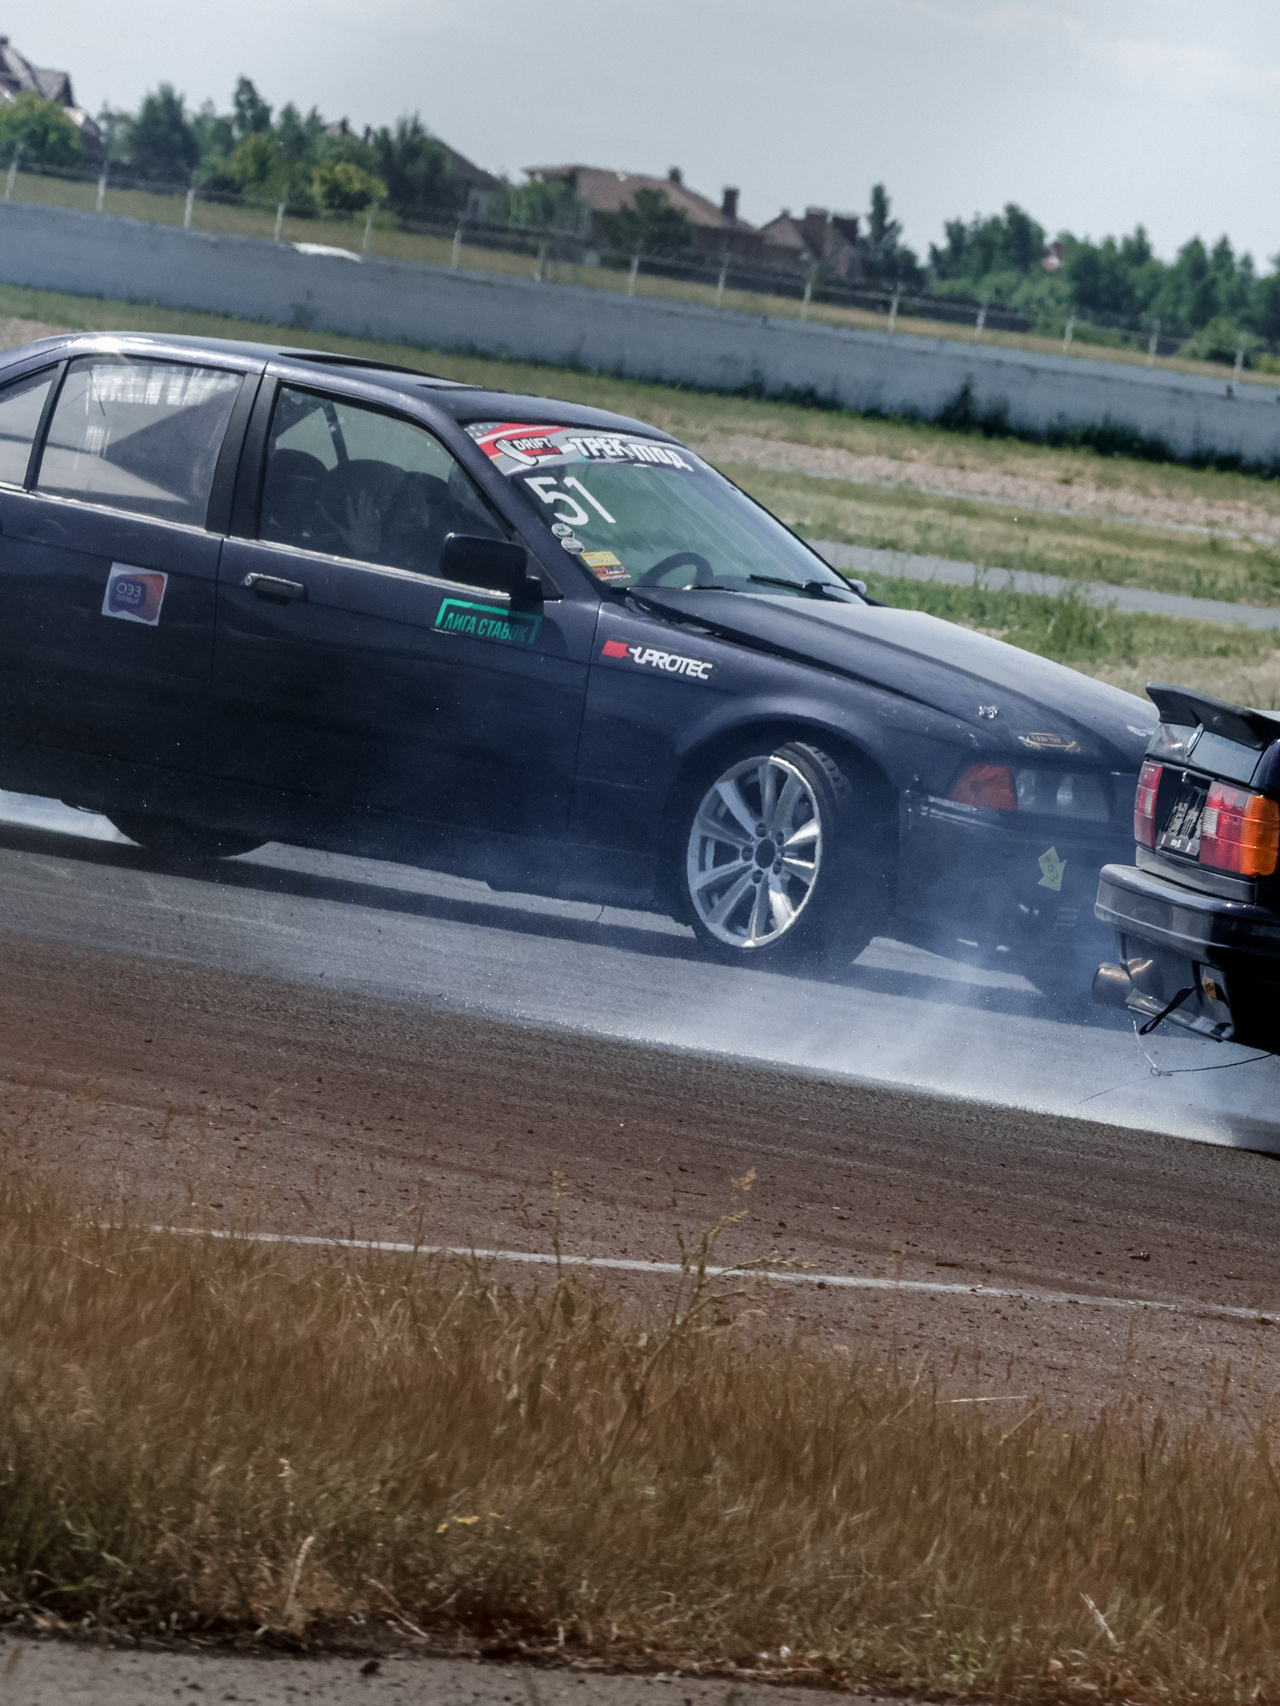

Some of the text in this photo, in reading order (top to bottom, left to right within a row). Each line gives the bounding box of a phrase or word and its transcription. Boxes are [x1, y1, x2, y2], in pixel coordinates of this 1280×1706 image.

[512, 437, 553, 451] DRIFT
[524, 476, 616, 526] 51
[444, 612, 529, 643] ЛИГА СТАВОК
